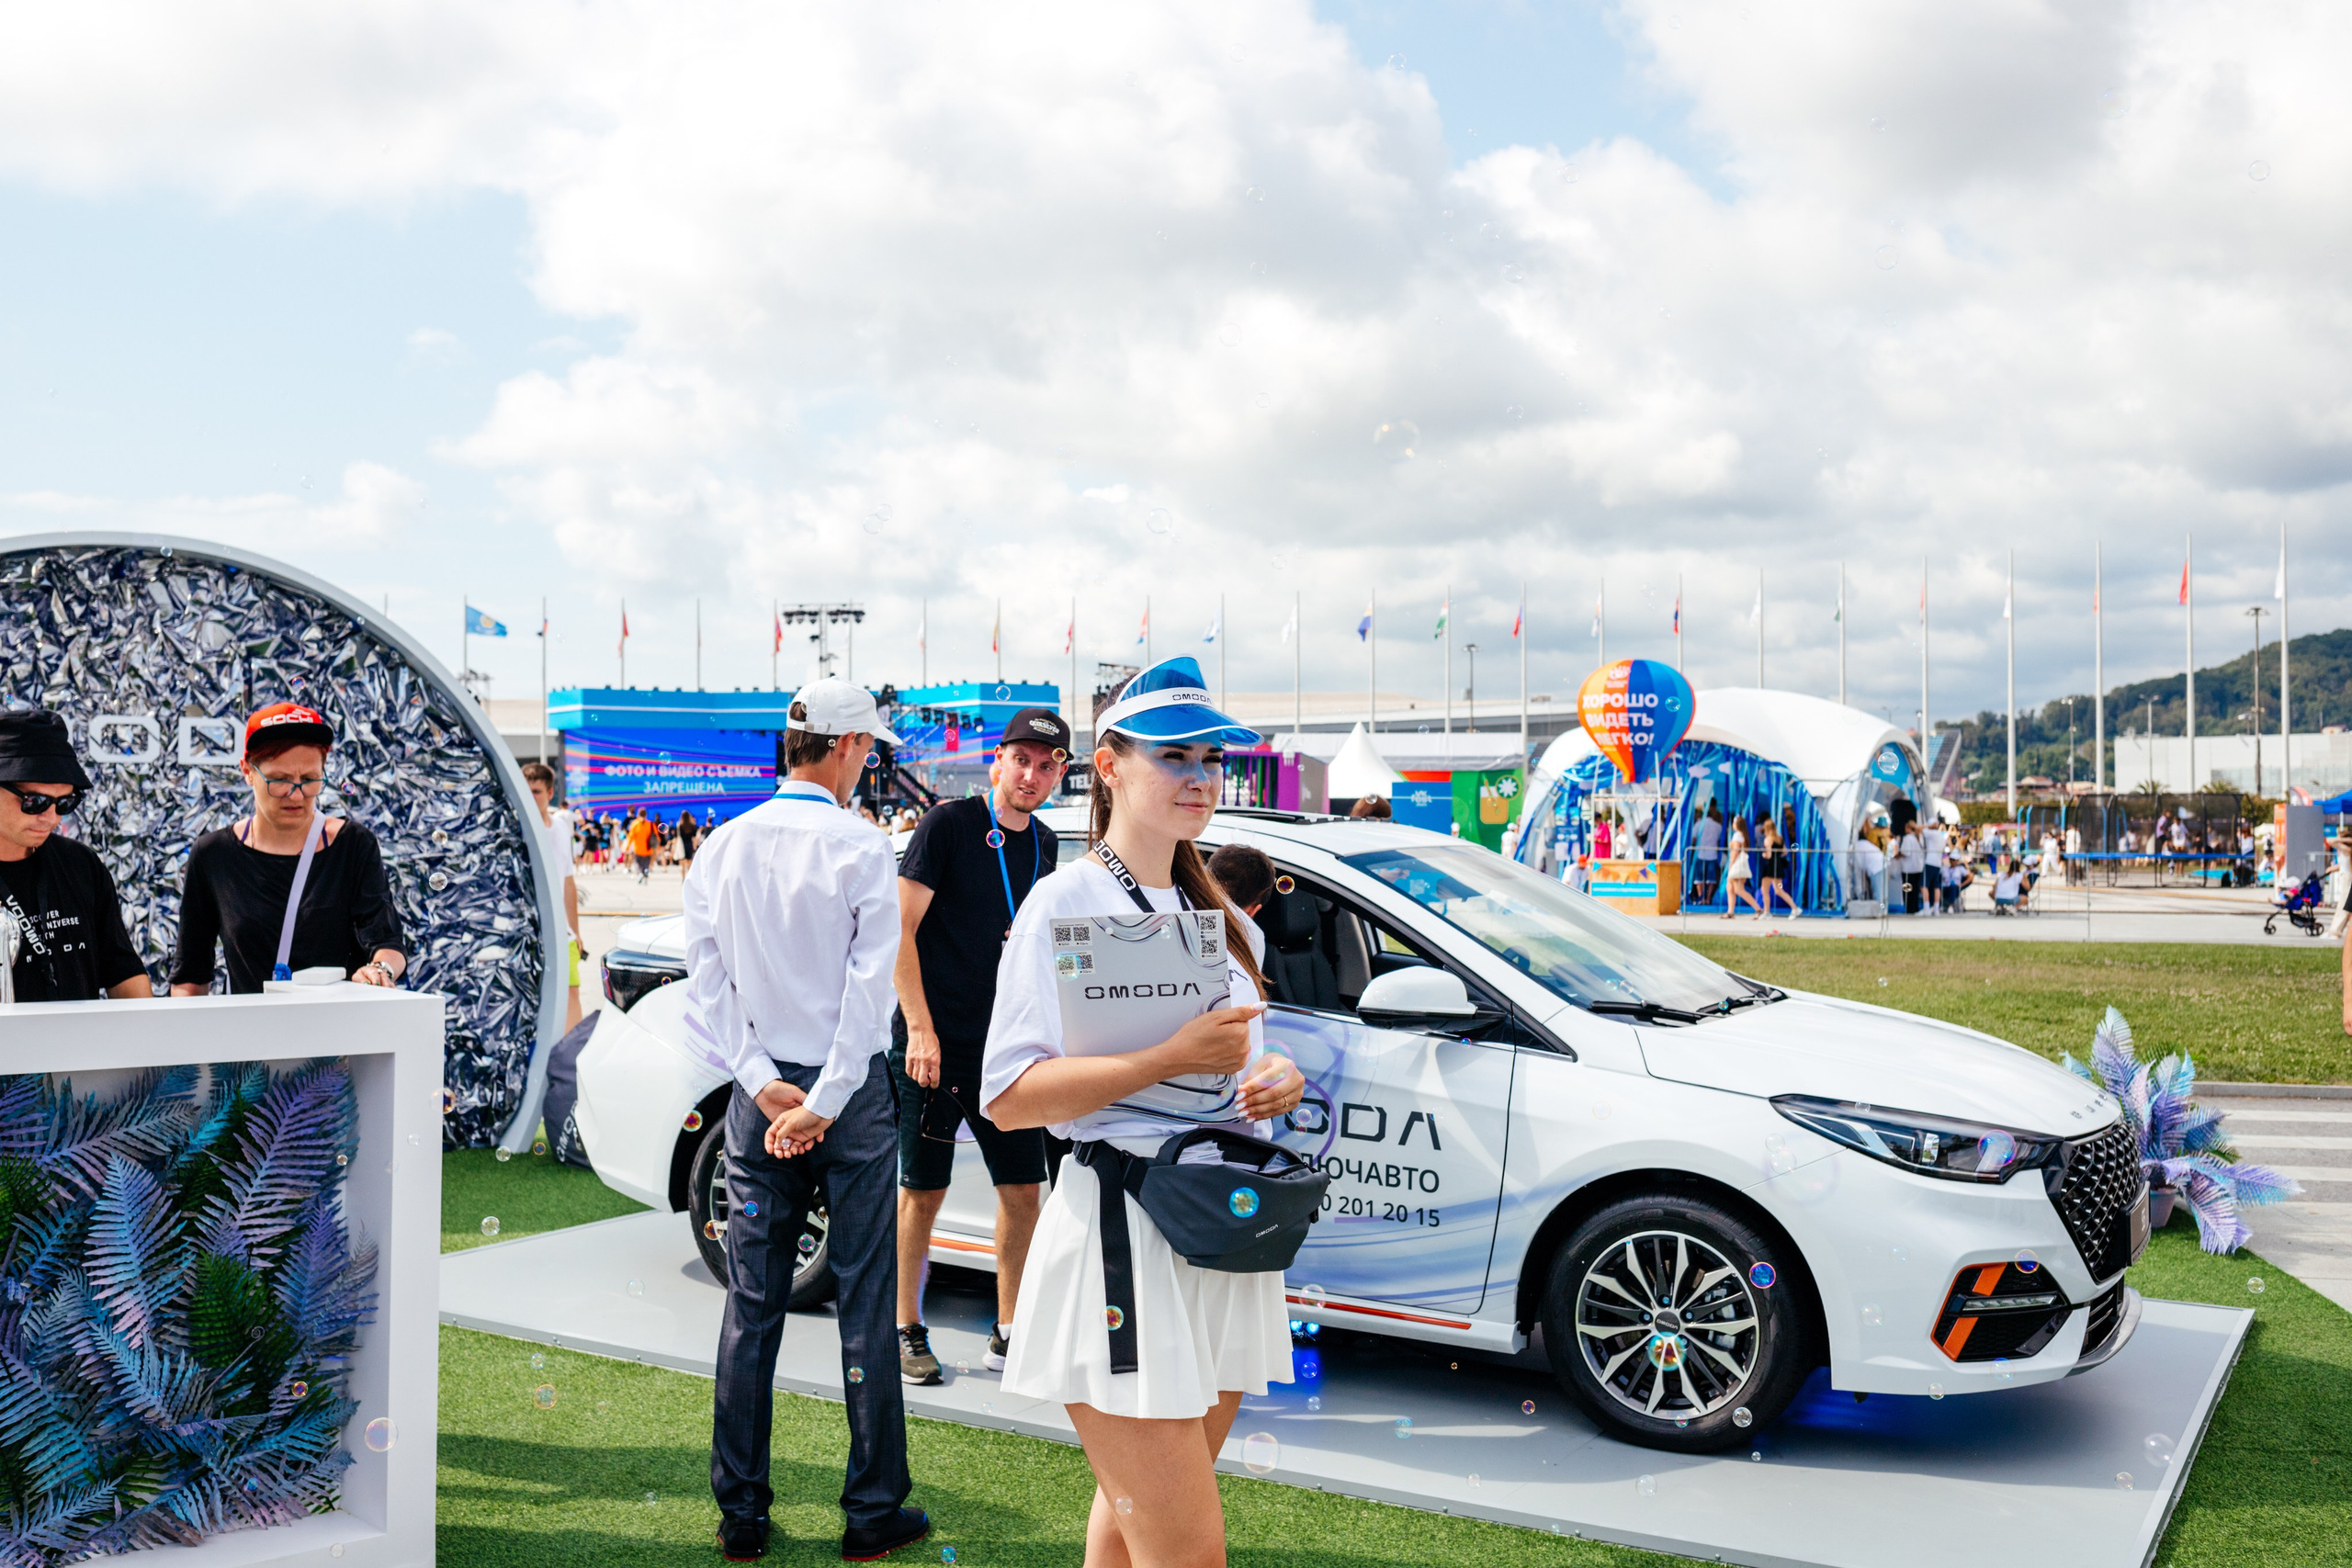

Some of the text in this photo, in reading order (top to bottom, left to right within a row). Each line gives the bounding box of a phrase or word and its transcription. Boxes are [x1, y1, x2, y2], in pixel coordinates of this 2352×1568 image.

[1582, 693, 1658, 708] ХОРОШО
[1585, 712, 1654, 728] ВИДЕТЬ
[1593, 732, 1655, 746] ЛЕГКО!
[605, 765, 763, 779] ФОТО И ВИДЕО СЪЕМКА
[643, 782, 725, 795] ЗАПРЕЩЕНА
[1085, 982, 1201, 1000] OMODA
[1284, 1097, 1442, 1151] ODA
[1339, 1196, 1374, 1218] 201
[1383, 1202, 1408, 1223] 20
[1416, 1208, 1441, 1227] 15
[1255, 1224, 1279, 1238] OMODA
